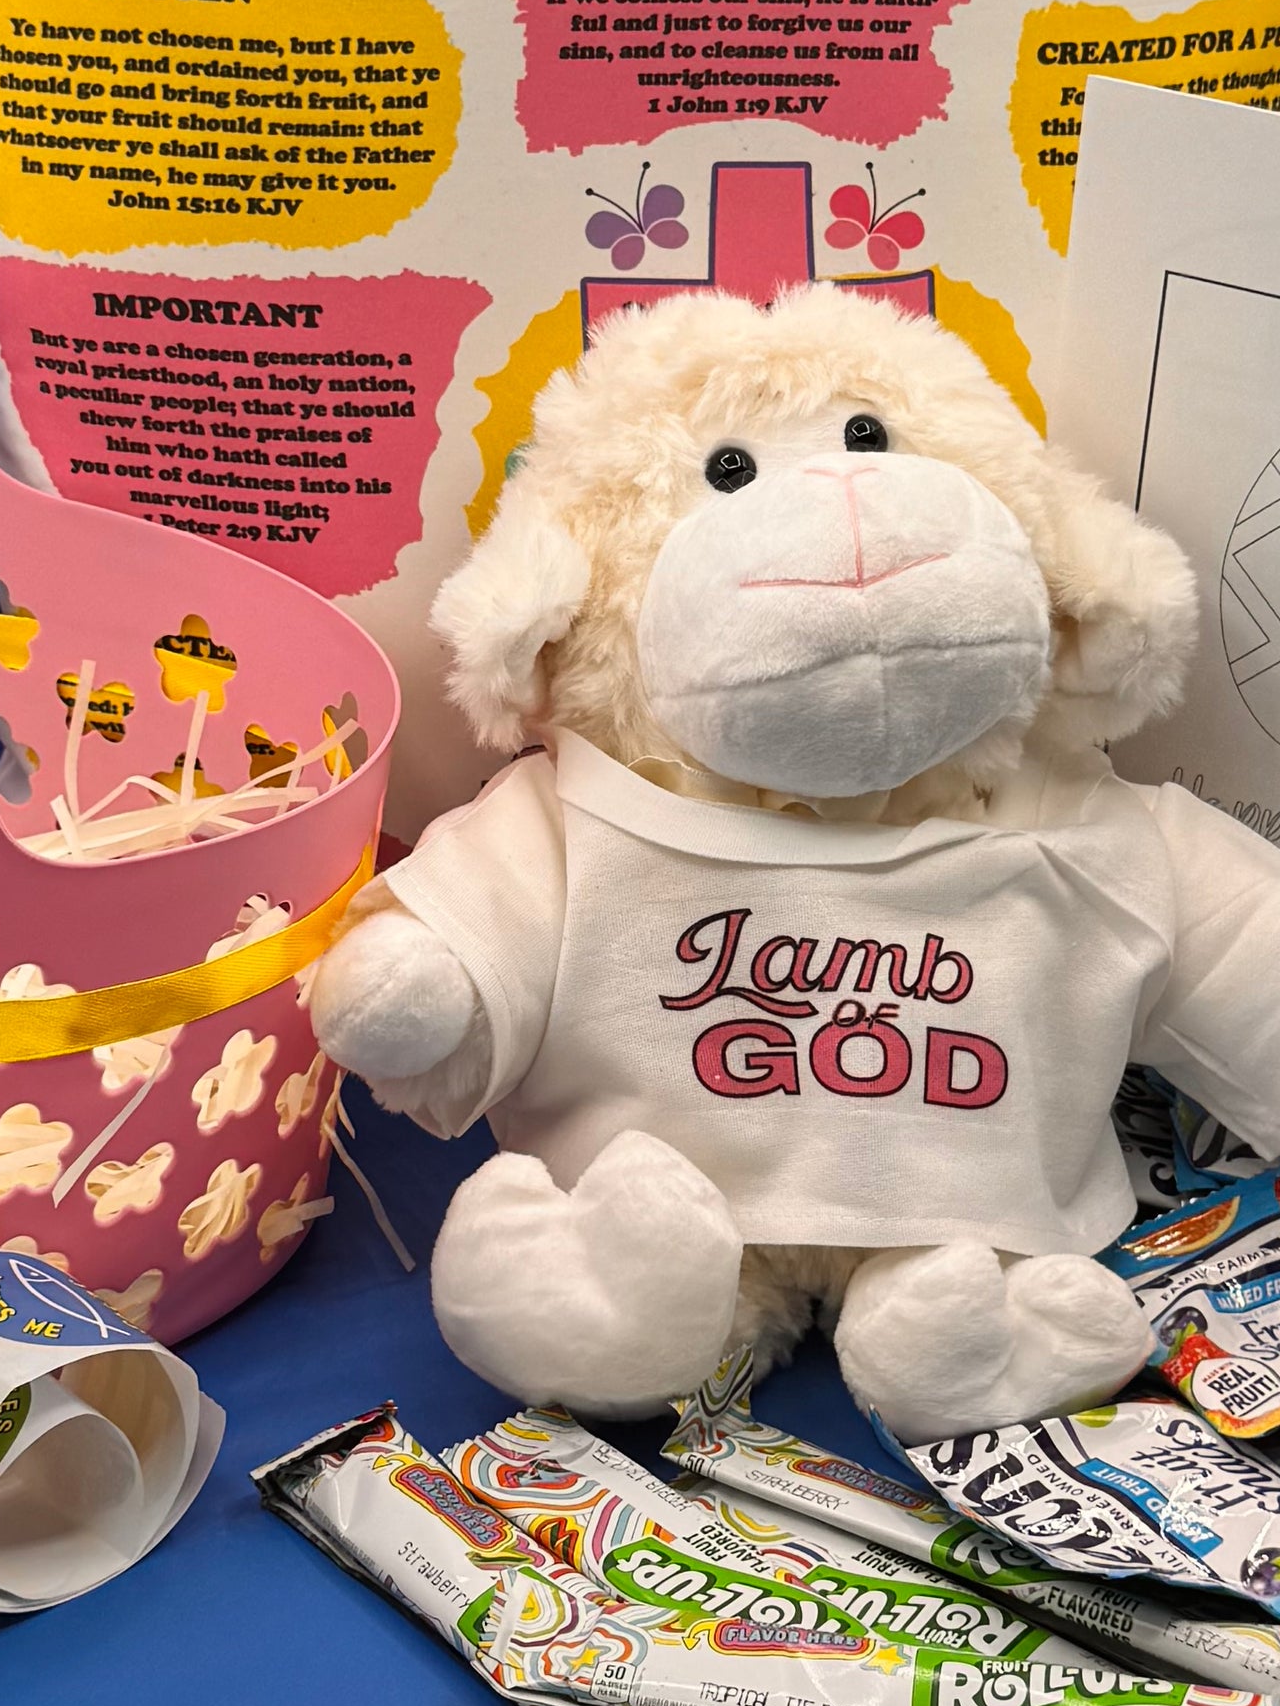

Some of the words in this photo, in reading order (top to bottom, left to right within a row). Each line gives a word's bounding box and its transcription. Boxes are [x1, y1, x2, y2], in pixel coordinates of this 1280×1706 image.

[1037, 36, 1177, 65] CREATED
[1182, 29, 1235, 57] FOR
[1237, 28, 1257, 51] A
[647, 98, 661, 113] 1
[665, 96, 729, 113] John
[734, 98, 771, 115] 1:9
[773, 96, 829, 114] KJV
[107, 190, 171, 210] John
[176, 196, 242, 214] 15:16
[245, 197, 303, 216] KJV
[92, 292, 324, 330] IMPORTANT
[159, 514, 222, 537] Peter
[225, 523, 263, 542] 2:9
[265, 524, 321, 544] KJV
[658, 908, 974, 1018] Lamb
[692, 1019, 1008, 1109] GOD
[22, 1317, 64, 1340] ME
[1208, 1363, 1259, 1395] REAL
[1220, 1375, 1280, 1416] FRUIT!
[1026, 1452, 1085, 1499] OWNED
[1092, 1466, 1152, 1501] FRUIT
[1087, 1492, 1154, 1546] FARMER
[681, 1532, 726, 1564] FRUIT
[699, 1524, 771, 1574] FLAVORED
[852, 1550, 899, 1578] FRUIT
[1047, 1587, 1134, 1632] FLAVORED
[727, 1627, 798, 1644] FLAVOR
[807, 1632, 857, 1646] HERE
[914, 1626, 968, 1650] FRUIT
[603, 1664, 627, 1680] 50
[982, 1659, 1031, 1674] FRUIT
